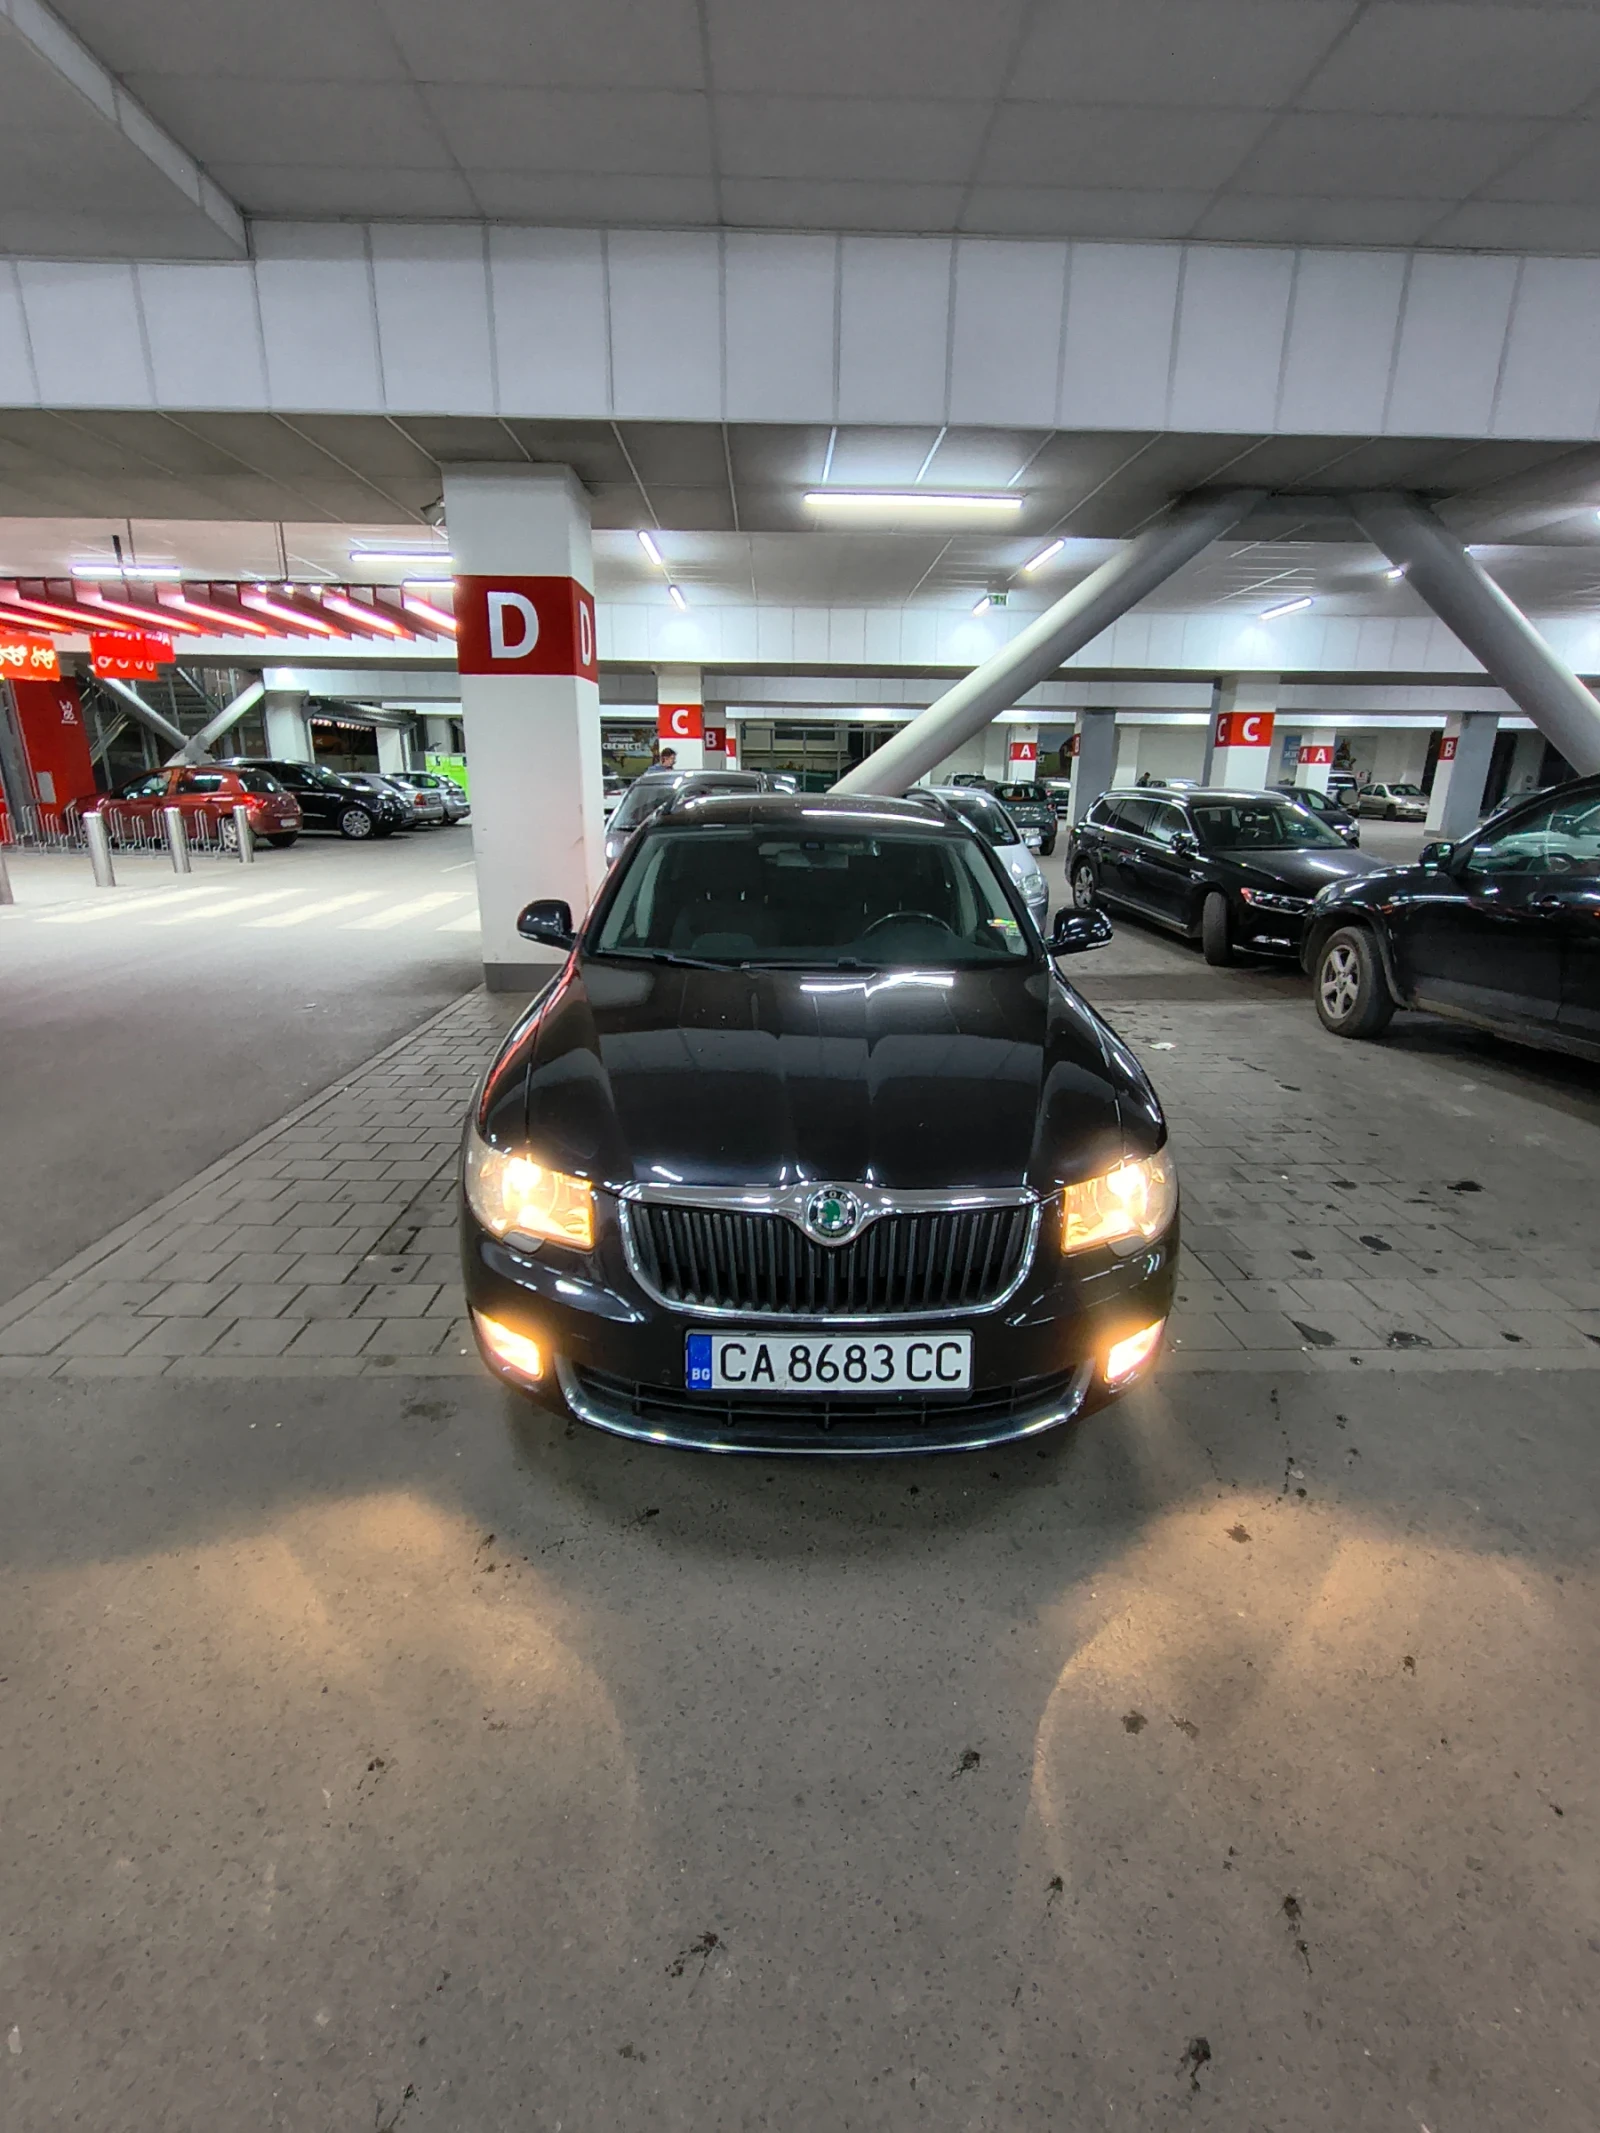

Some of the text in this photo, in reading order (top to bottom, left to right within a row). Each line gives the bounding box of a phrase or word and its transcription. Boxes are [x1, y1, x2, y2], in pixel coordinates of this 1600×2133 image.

[487, 591, 539, 659] D
[579, 600, 591, 666] D
[671, 709, 689, 735] C
[1217, 718, 1227, 742] C
[1242, 717, 1260, 741] C
[705, 731, 717, 748] B
[1444, 741, 1454, 757] B
[1020, 744, 1032, 758] A
[1301, 748, 1308, 762] A
[1315, 748, 1326, 762] A
[720, 1342, 962, 1384] CA 8683 CC
[692, 1367, 711, 1381] BG
